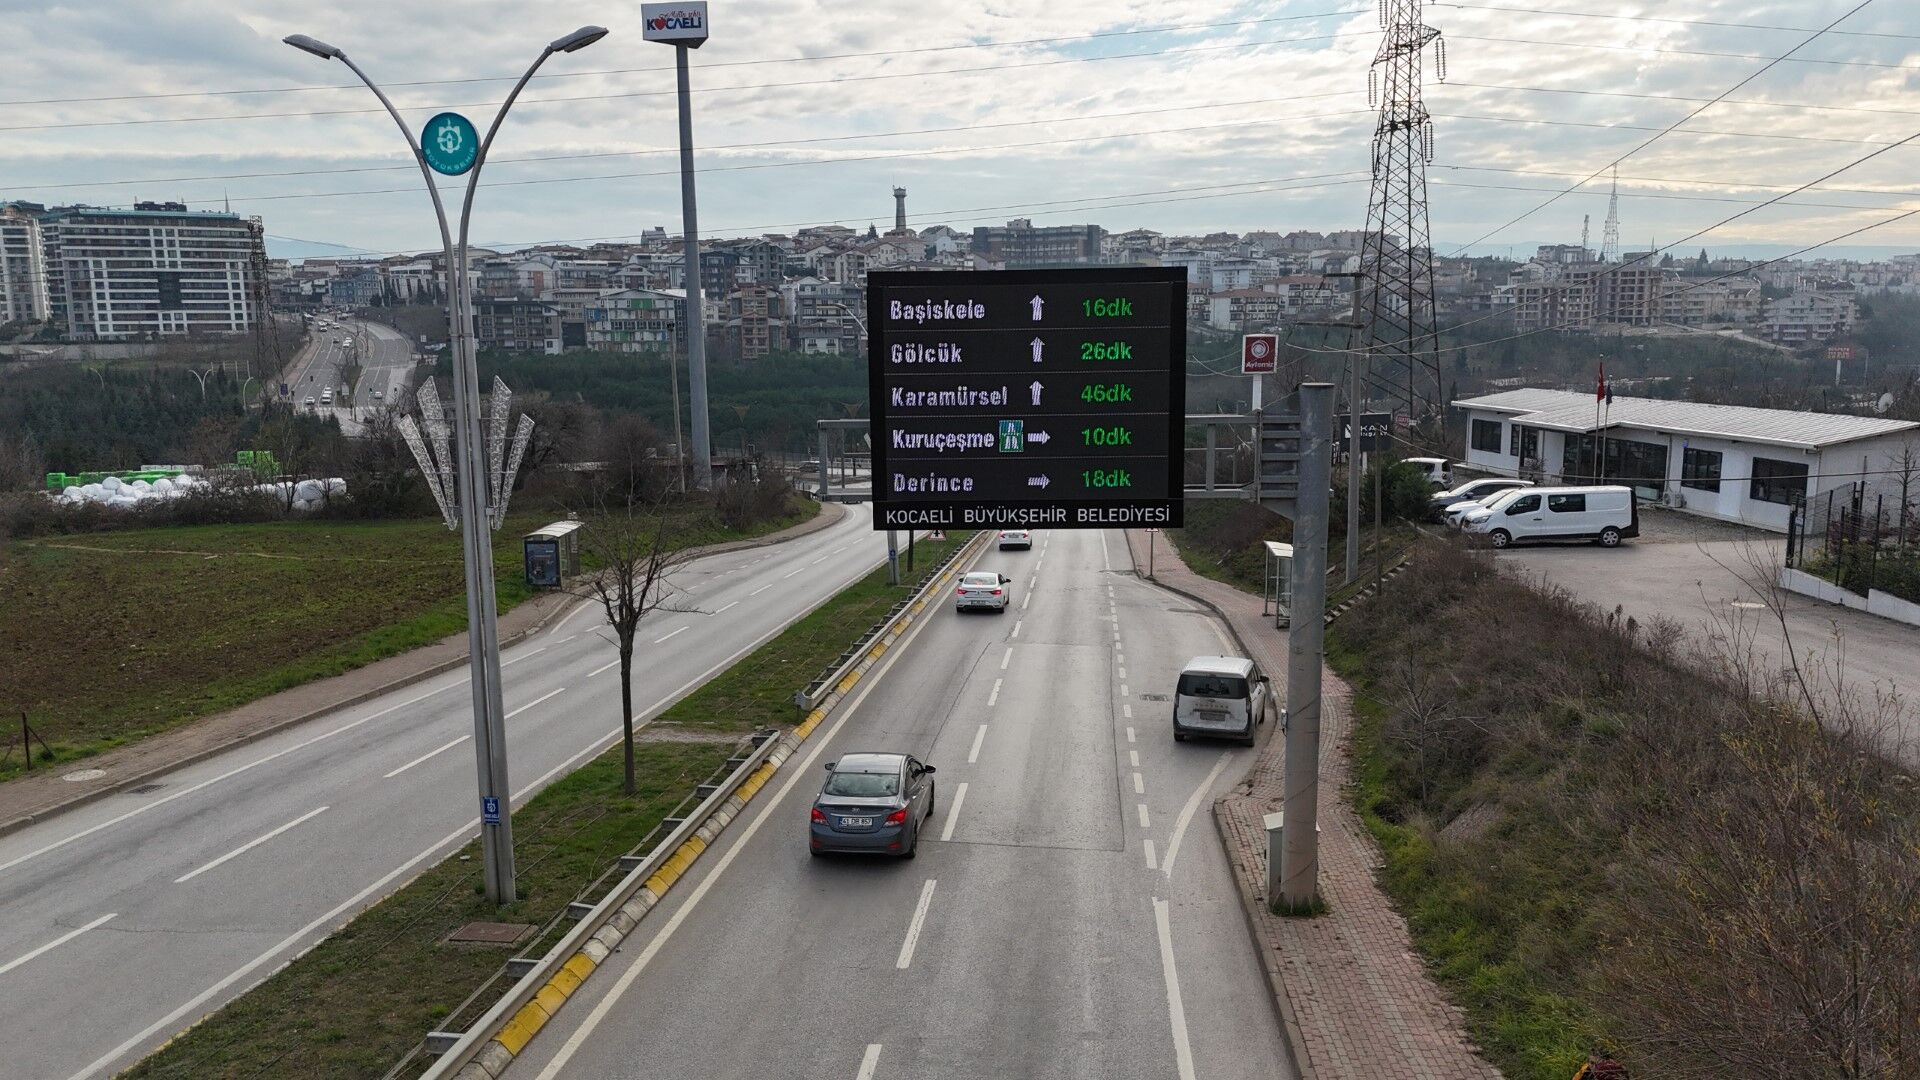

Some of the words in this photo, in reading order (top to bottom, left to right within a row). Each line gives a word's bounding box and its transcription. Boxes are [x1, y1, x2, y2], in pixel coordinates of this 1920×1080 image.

[890, 298, 985, 324] Başiskele
[1082, 298, 1133, 317] 16dk
[891, 342, 963, 364] Gölcük
[1081, 342, 1133, 360] 26dk
[891, 386, 1008, 407] Karamürsel
[1081, 384, 1132, 402] 46dk
[892, 429, 995, 452] Kuruçeşme
[1081, 427, 1132, 446] 10dk
[893, 473, 974, 492] Derince
[1081, 469, 1132, 488] 18dk
[886, 506, 953, 524] KOCAELİ
[964, 506, 1066, 525] BÜYÜKŞEHİR
[1077, 504, 1170, 522] BELEDİYESİ
